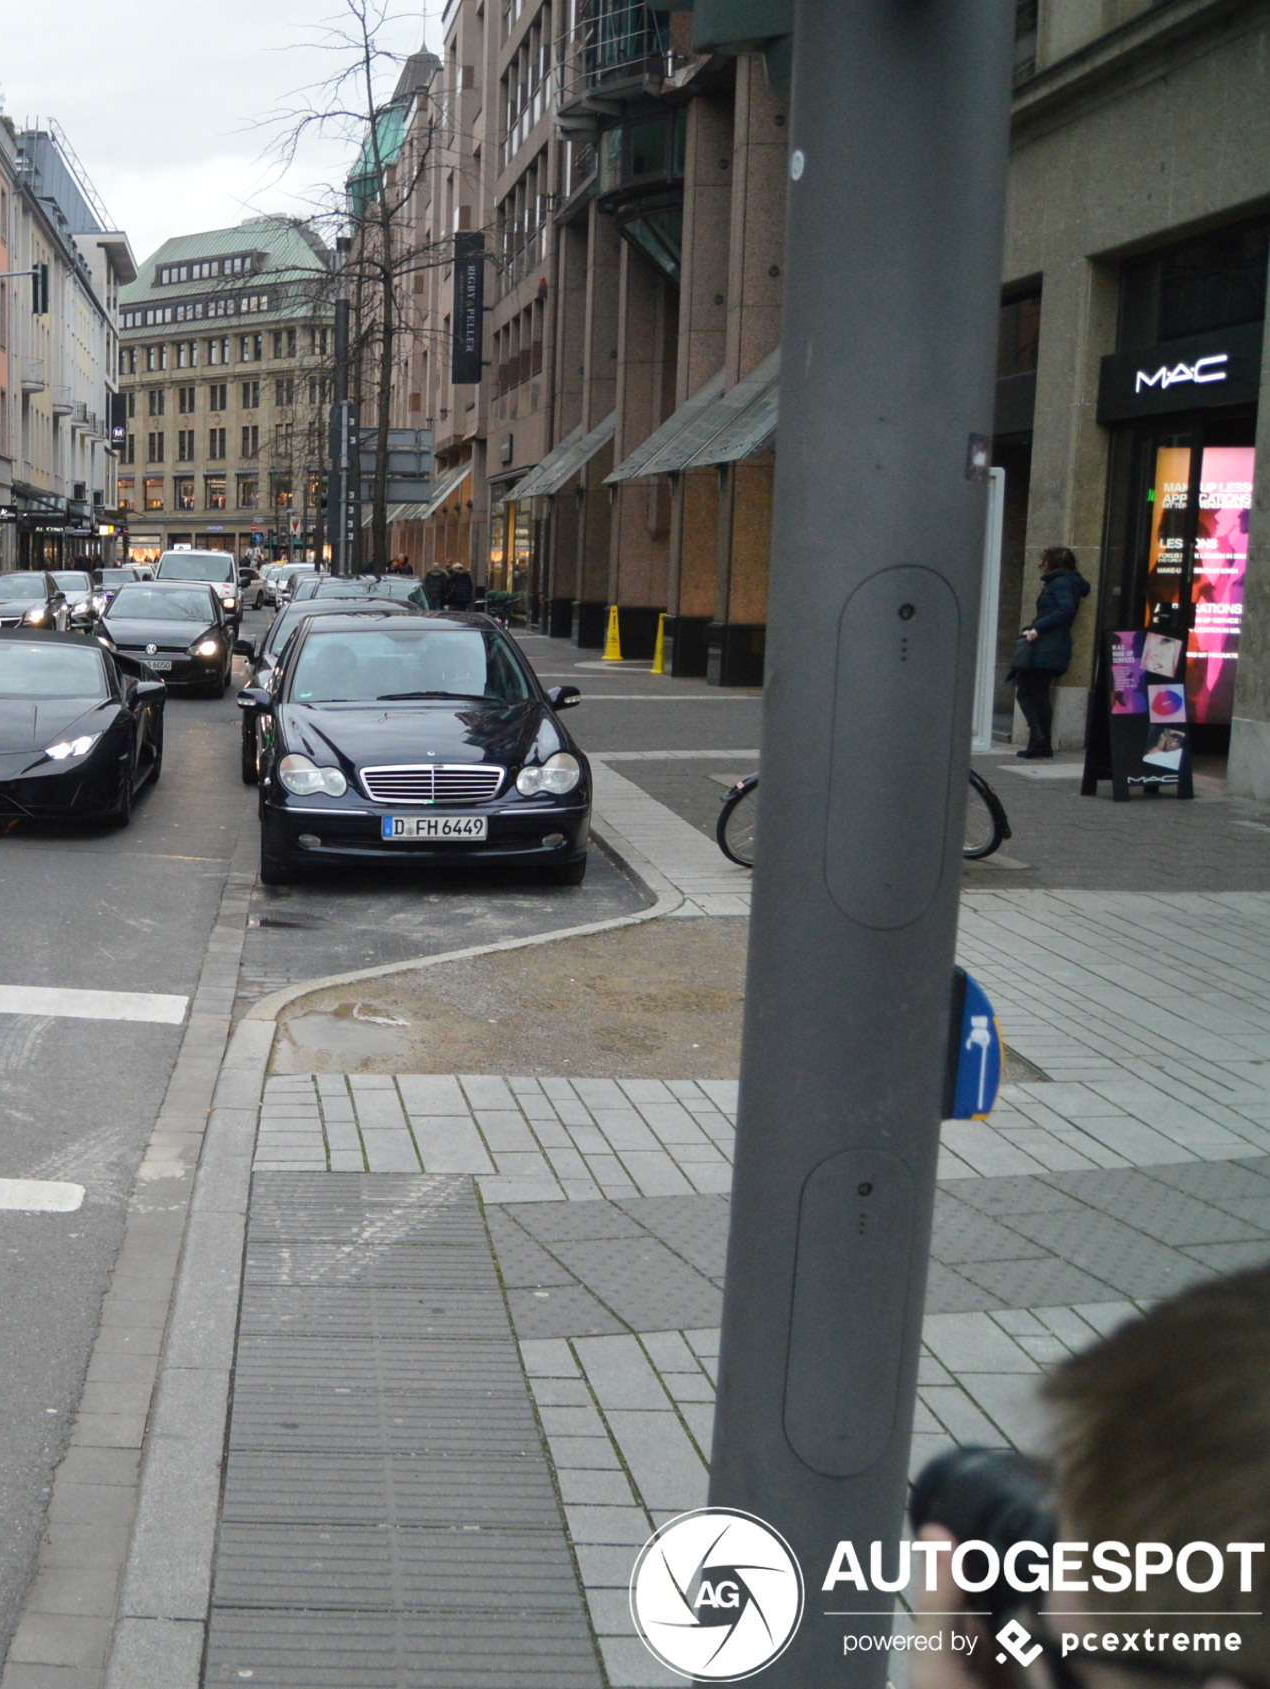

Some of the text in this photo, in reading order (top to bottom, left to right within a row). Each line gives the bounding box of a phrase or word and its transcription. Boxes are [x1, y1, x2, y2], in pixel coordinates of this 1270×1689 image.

[466, 265, 476, 299] RIGBY
[465, 308, 475, 352] PELLER
[394, 819, 483, 835] D FH 6449
